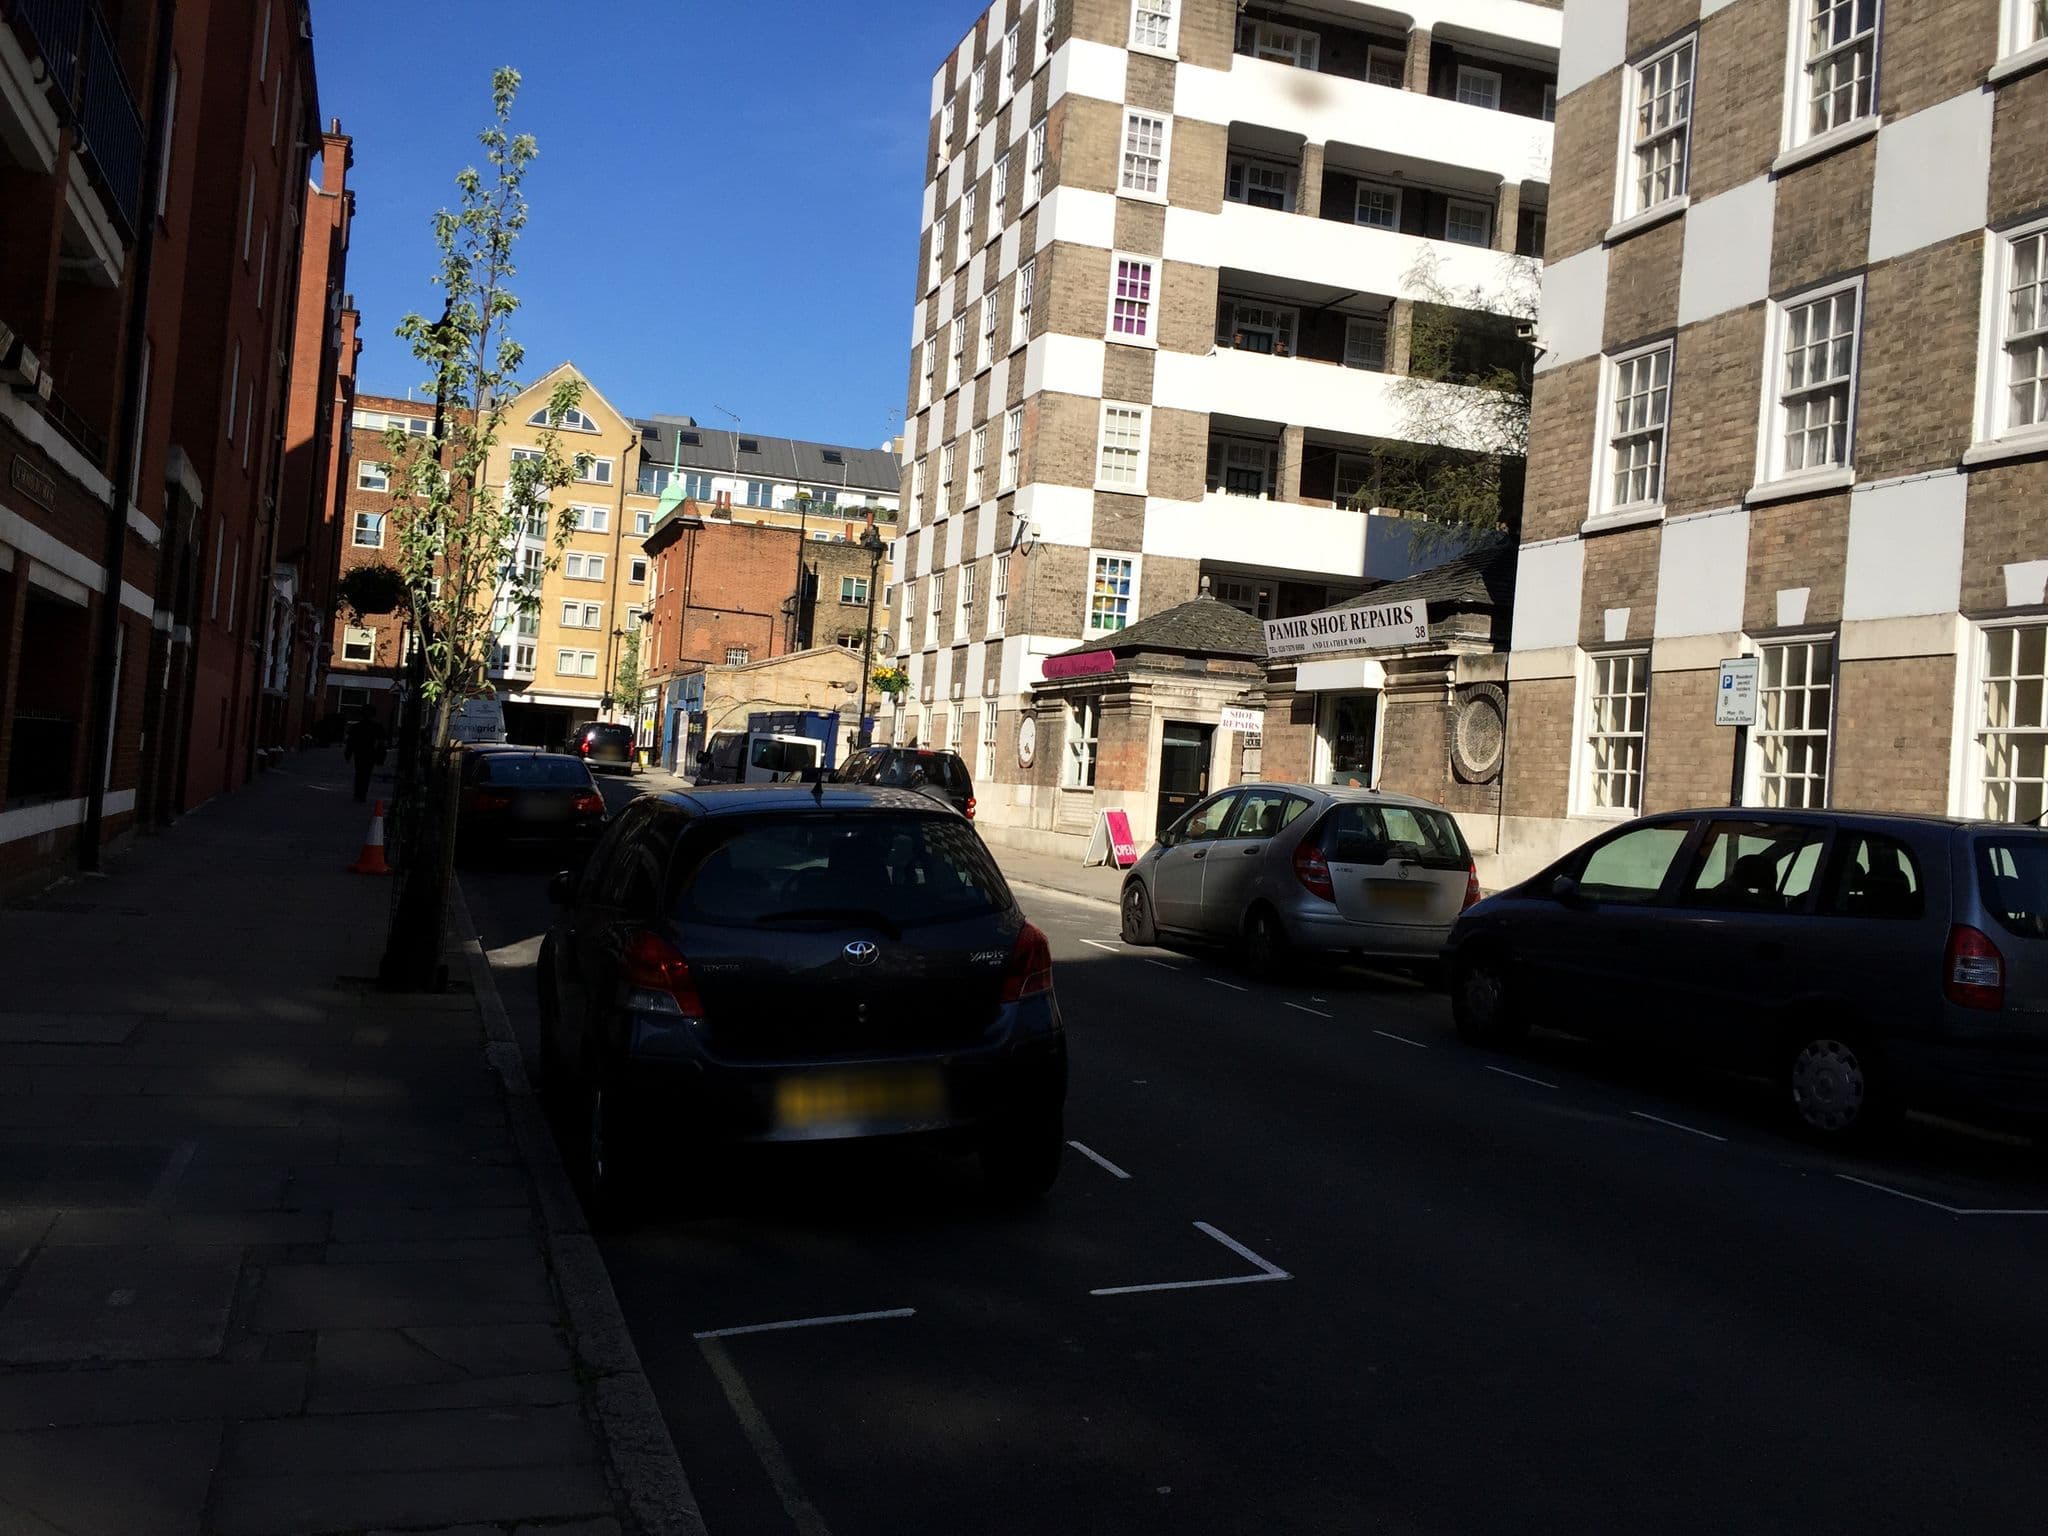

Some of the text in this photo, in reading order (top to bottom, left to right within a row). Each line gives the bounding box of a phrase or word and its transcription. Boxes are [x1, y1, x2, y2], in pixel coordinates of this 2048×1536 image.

[1269, 605, 1413, 641] PAMIR SHOE REPAIRS
[1414, 626, 1426, 639] 38
[1312, 641, 1323, 649] AND
[1323, 639, 1348, 648] LEATHER
[1349, 637, 1367, 645] WORK
[1230, 711, 1252, 719] SHOE
[1223, 719, 1259, 730] REPAIRS
[1115, 844, 1136, 856] OPEN
